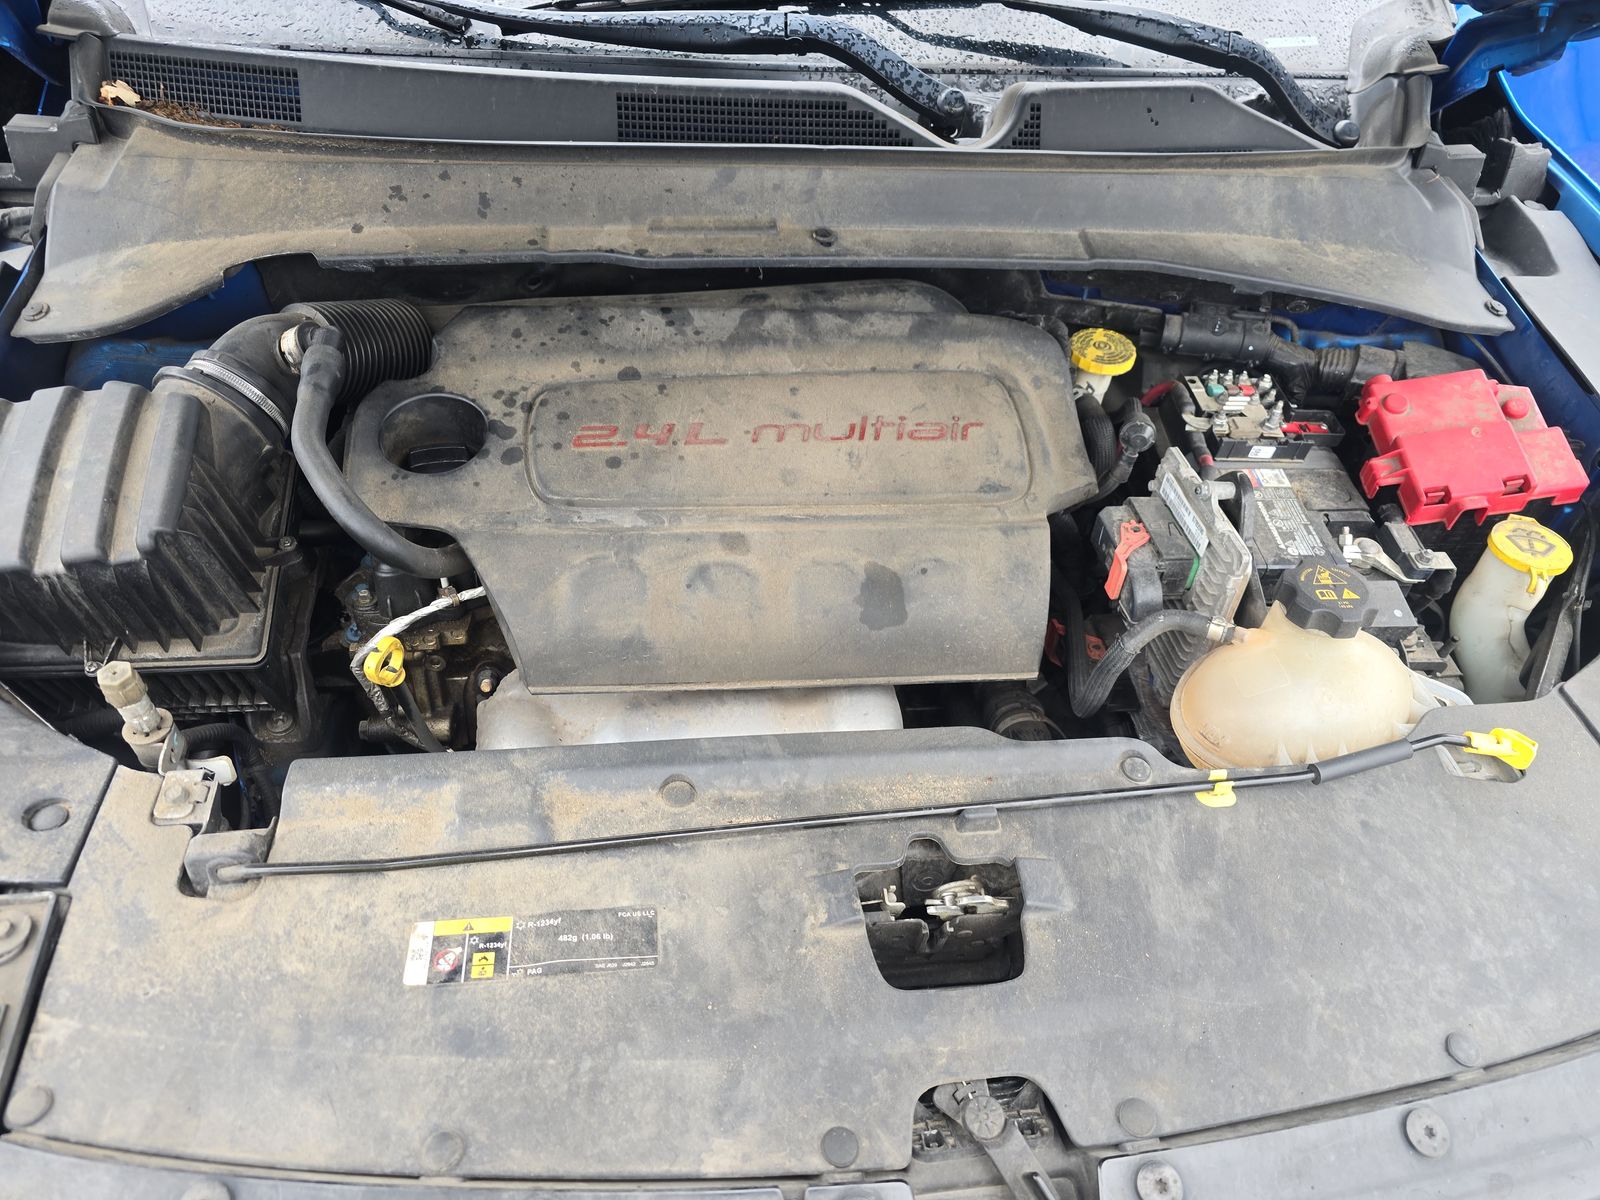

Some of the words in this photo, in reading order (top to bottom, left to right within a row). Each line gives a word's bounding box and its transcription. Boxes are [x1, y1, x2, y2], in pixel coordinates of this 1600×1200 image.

[572, 421, 729, 448] 2.4L
[751, 415, 984, 443] multiair
[527, 917, 561, 928] R-1234yf
[558, 934, 577, 943] 482g
[602, 932, 614, 941] lb)
[478, 941, 508, 949] R-1234yf
[527, 967, 542, 975] PAG
